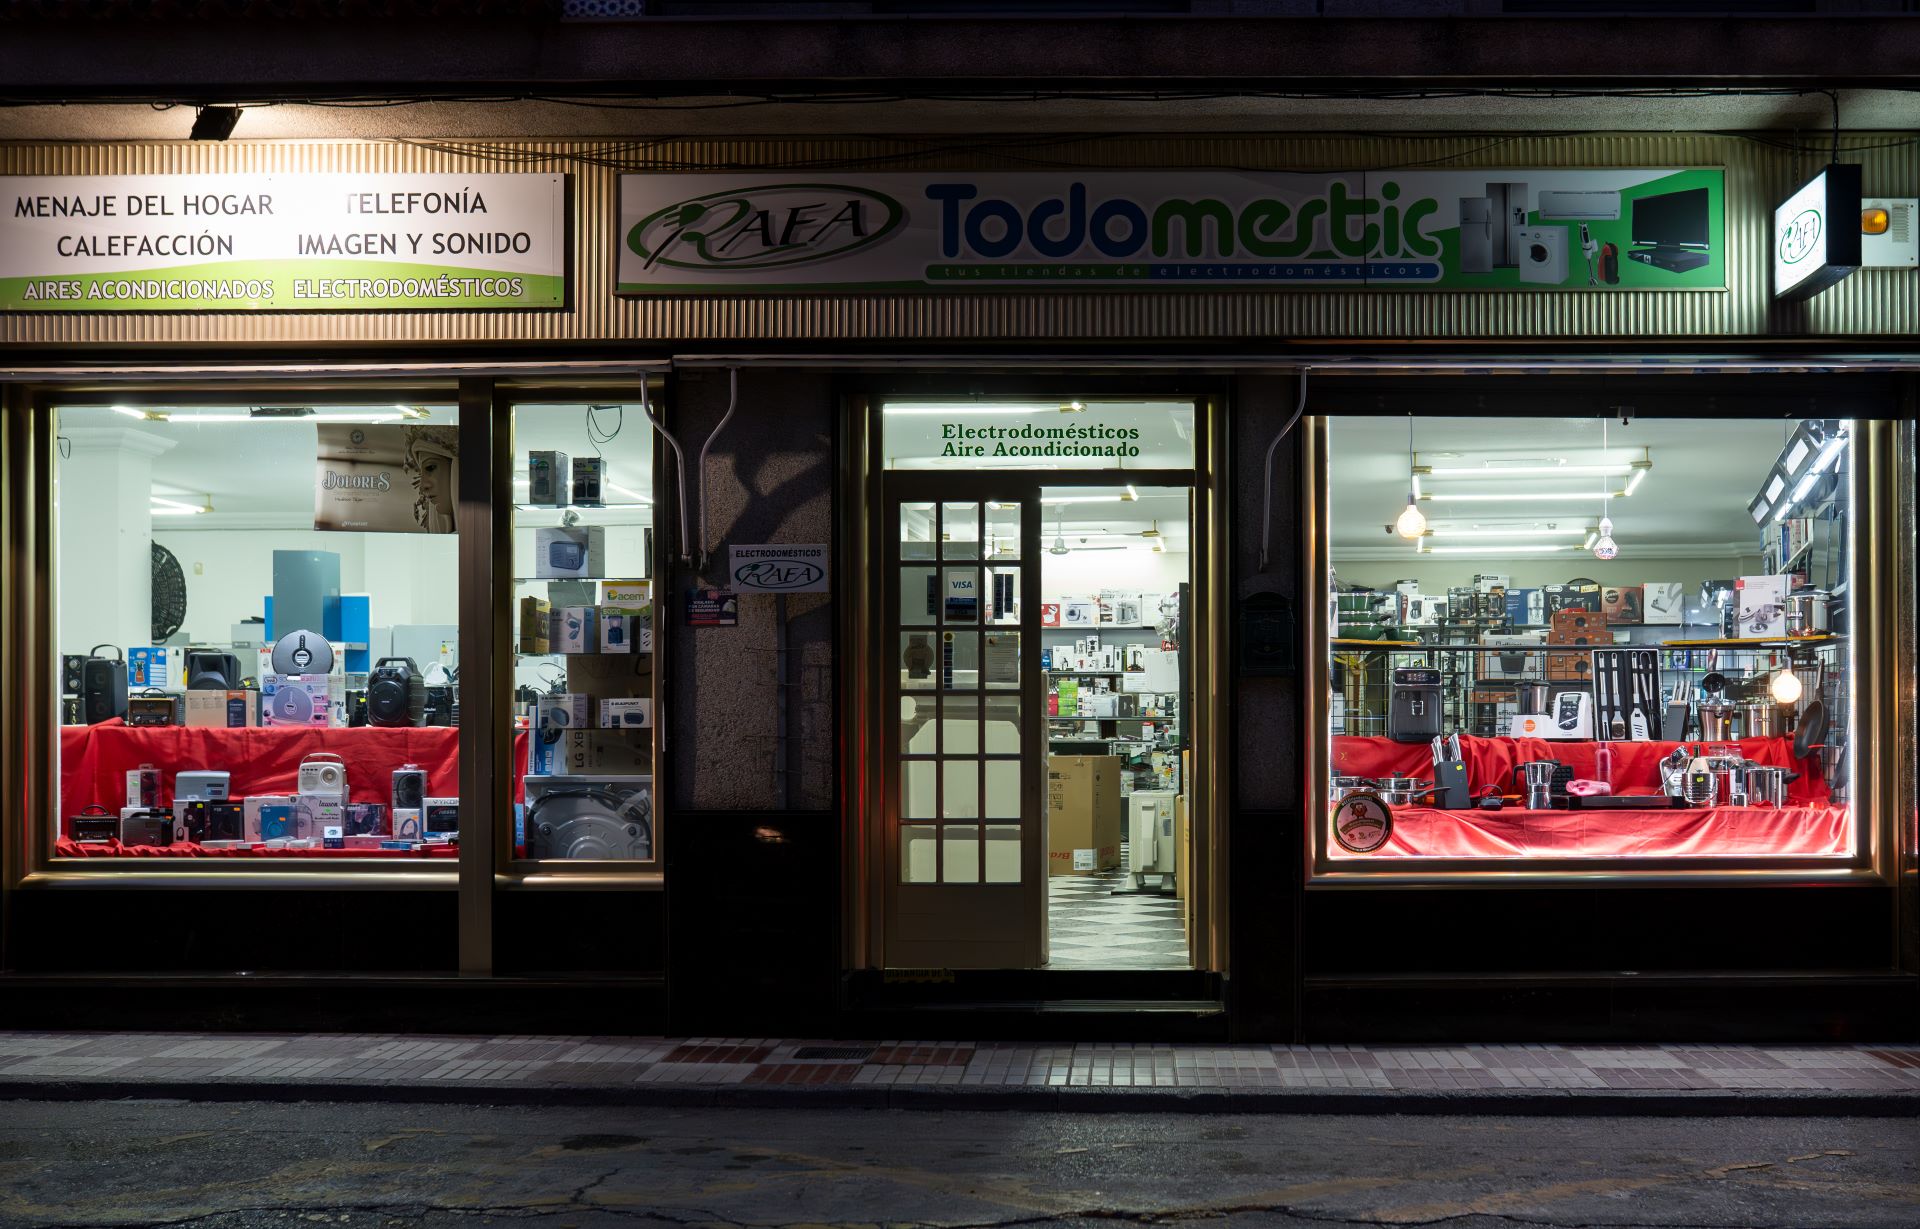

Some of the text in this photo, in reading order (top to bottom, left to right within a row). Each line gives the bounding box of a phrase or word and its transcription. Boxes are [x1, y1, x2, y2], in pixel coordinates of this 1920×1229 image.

[14, 193, 274, 217] MENAJE DEL HOGAR
[345, 186, 488, 214] TELEFONÍA
[925, 182, 1438, 258] Todomestic
[57, 230, 233, 257] CALEFACCIÓN
[298, 231, 532, 255] IMAGEN Y SONIDO
[643, 197, 869, 271] RAFA
[944, 263, 1423, 278] tus tiendas de electrodomésticos
[23, 277, 274, 300] AIRES ACONDICIONADOS
[293, 273, 524, 299] ELECTRODOMÉSTICOS
[941, 423, 1139, 439] Electrodomésticos
[941, 441, 1140, 457] Aire Acondicionado
[322, 470, 391, 493] DOLORES
[735, 548, 822, 558] ELECTRODOMÉSTICOS
[738, 563, 812, 586] RAFA
[952, 581, 973, 589] VISA
[574, 753, 585, 769] LG
